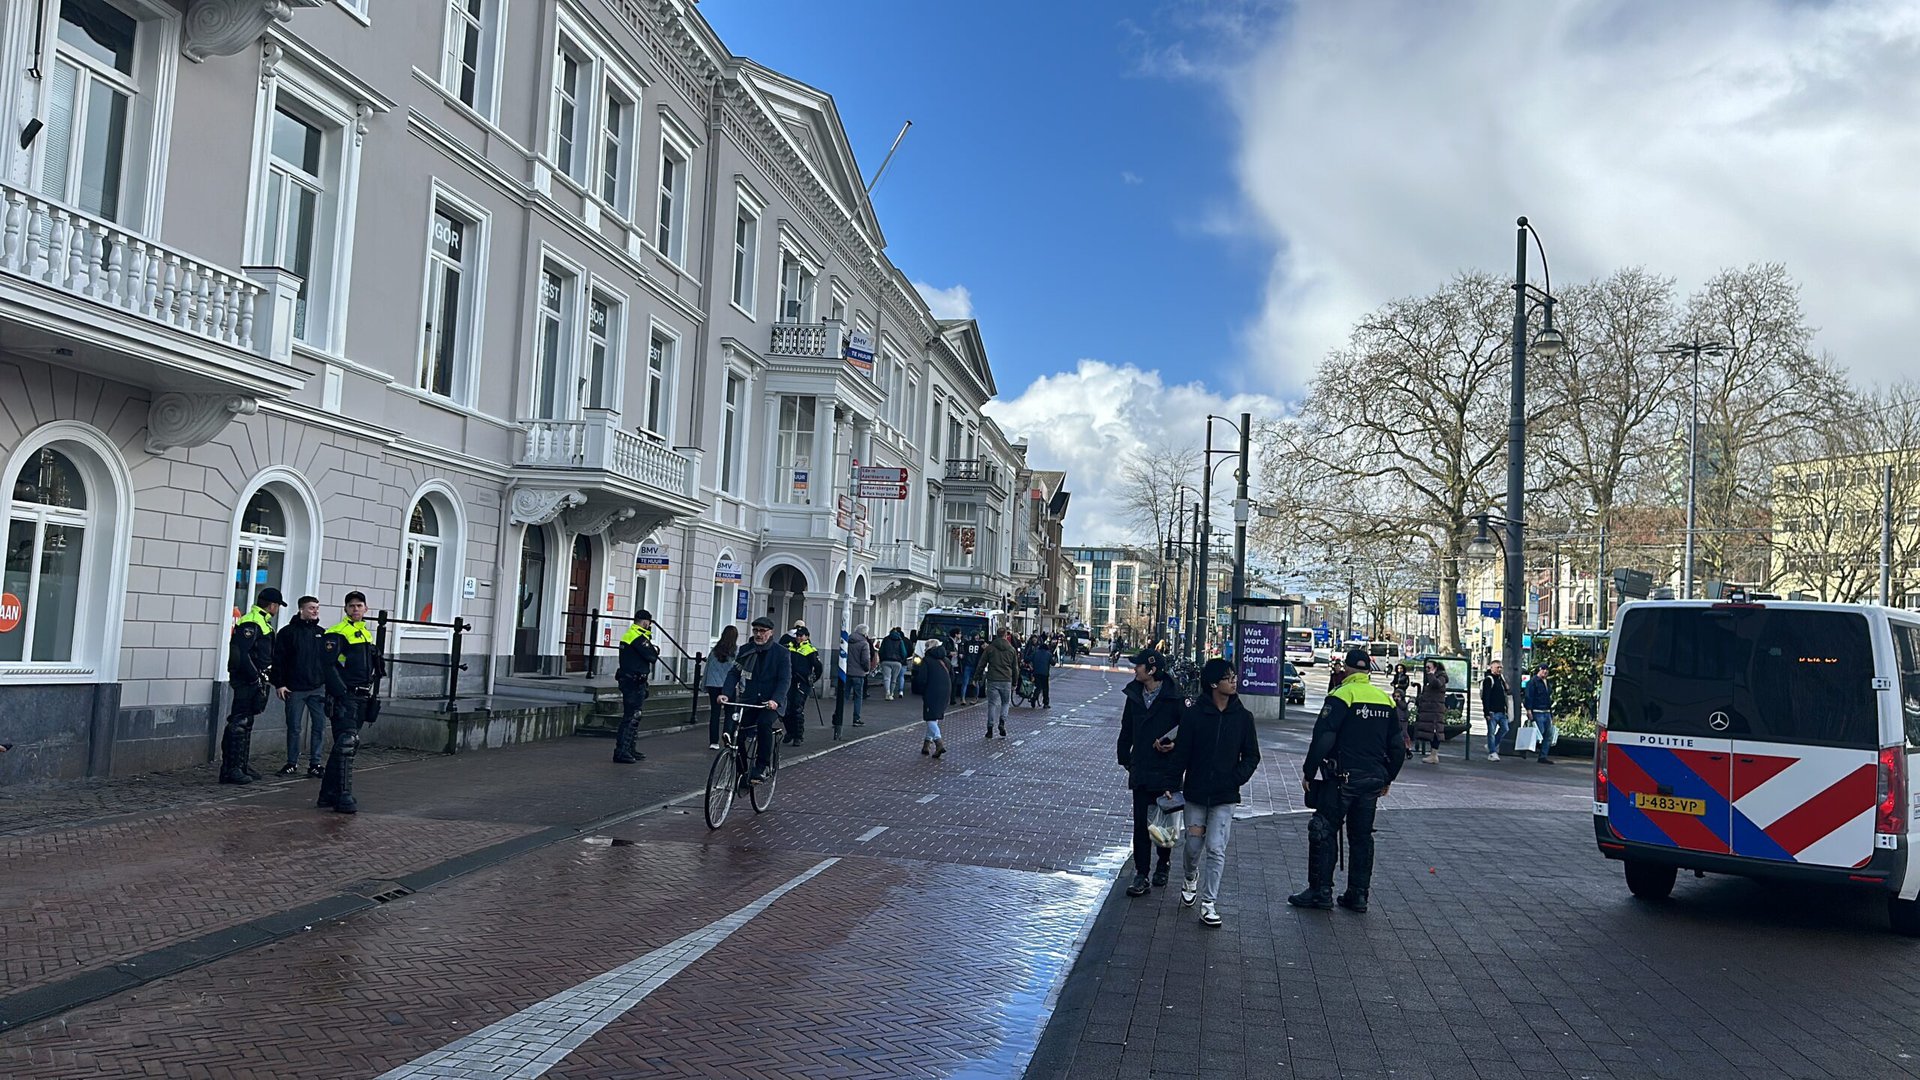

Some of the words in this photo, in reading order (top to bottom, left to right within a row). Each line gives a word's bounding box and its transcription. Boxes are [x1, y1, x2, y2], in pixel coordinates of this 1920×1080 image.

[435, 222, 459, 249] GOR
[853, 336, 867, 346] BMV
[717, 562, 732, 570] BMV
[1244, 628, 1262, 637] Wat
[1244, 638, 1270, 646] wordt
[1243, 646, 1265, 655] jouw
[1243, 655, 1278, 664] domein?
[1640, 736, 1694, 747] POLITIE
[1639, 796, 1697, 812] J-483-VP
